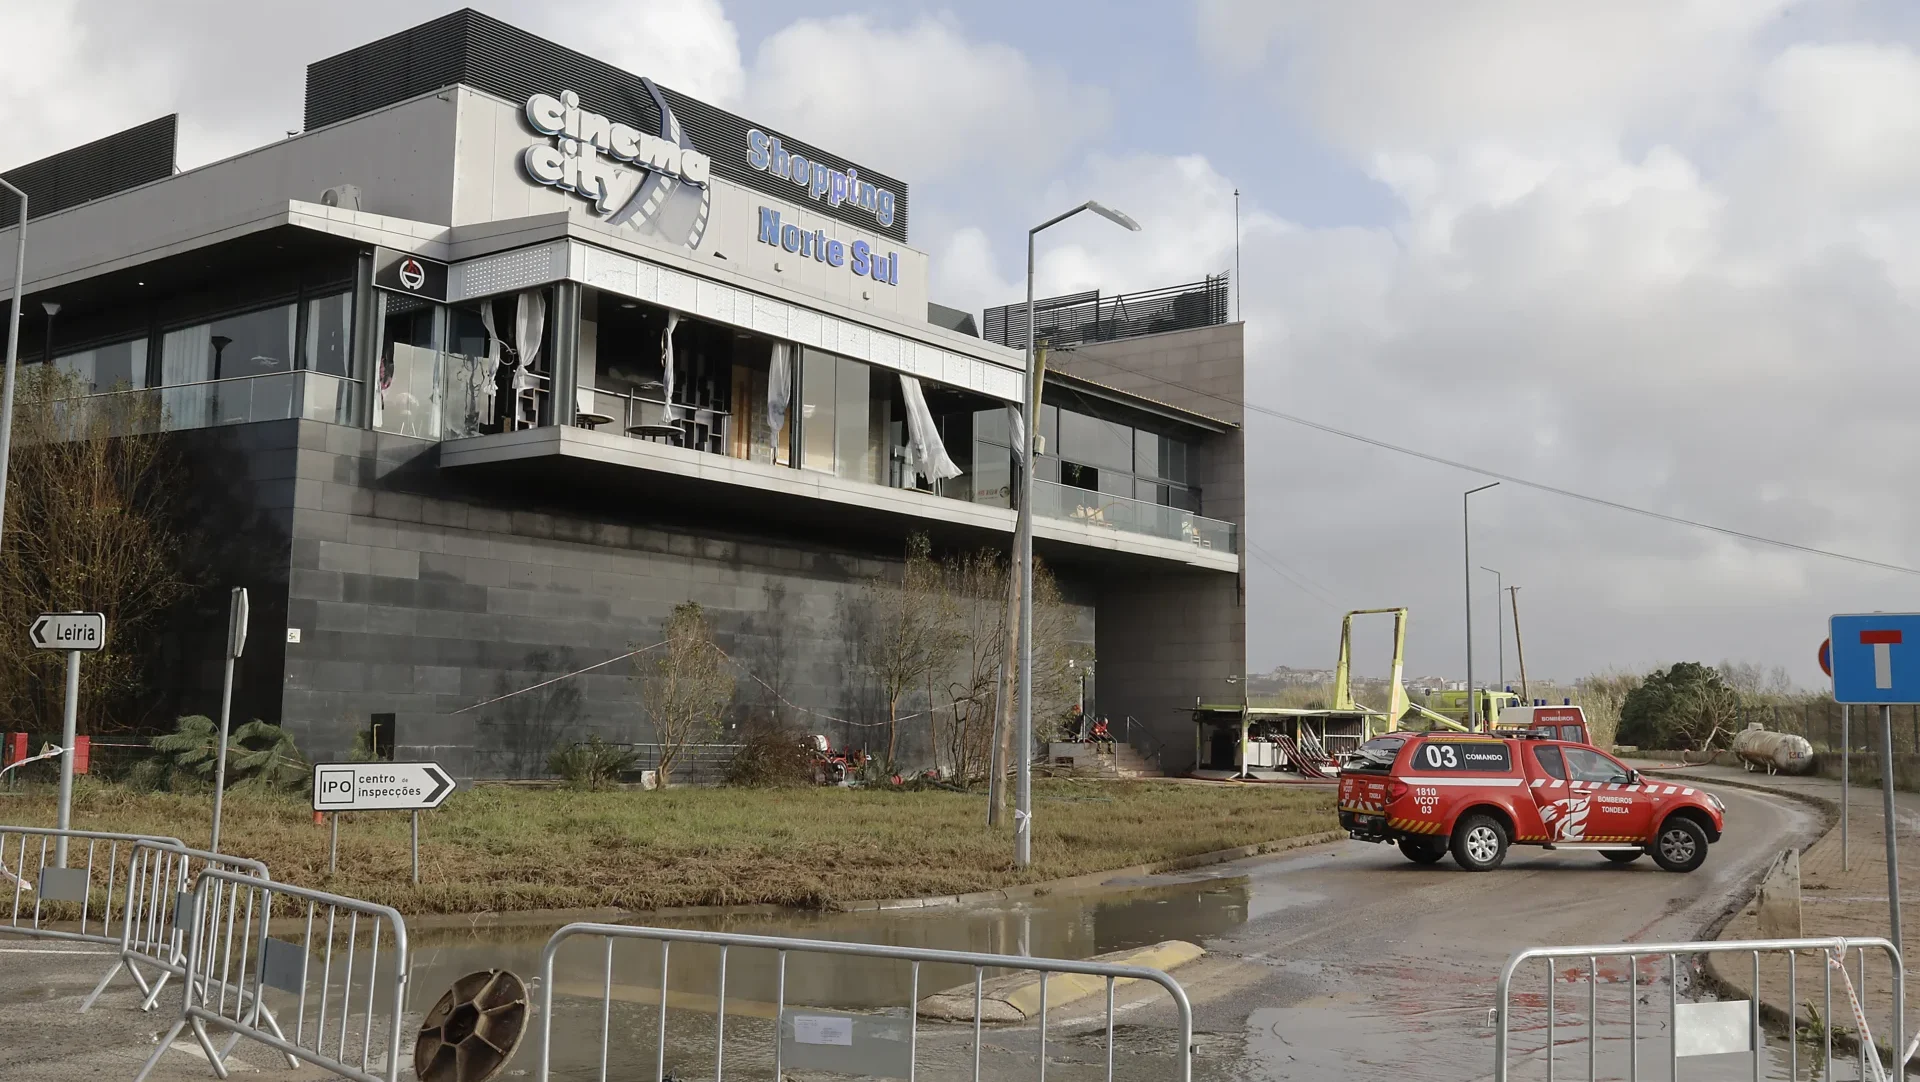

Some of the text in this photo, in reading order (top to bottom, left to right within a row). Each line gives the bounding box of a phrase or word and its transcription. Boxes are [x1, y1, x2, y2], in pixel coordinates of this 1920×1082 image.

[526, 90, 711, 189] cinema
[525, 138, 634, 215] city
[747, 129, 895, 227] Shopping
[758, 206, 899, 286] Norte Sul
[57, 624, 95, 641] Leiria
[1426, 745, 1458, 768] 03
[1465, 753, 1503, 761] COMANDO
[359, 774, 396, 784] centro
[323, 780, 352, 793] IPO
[358, 786, 421, 798] inspecções
[1415, 787, 1437, 796] 1810
[1413, 796, 1440, 805] VCOT
[1597, 796, 1633, 804] BOMBEIROS
[1421, 806, 1432, 814] 03
[1601, 805, 1629, 814] TONDELA
